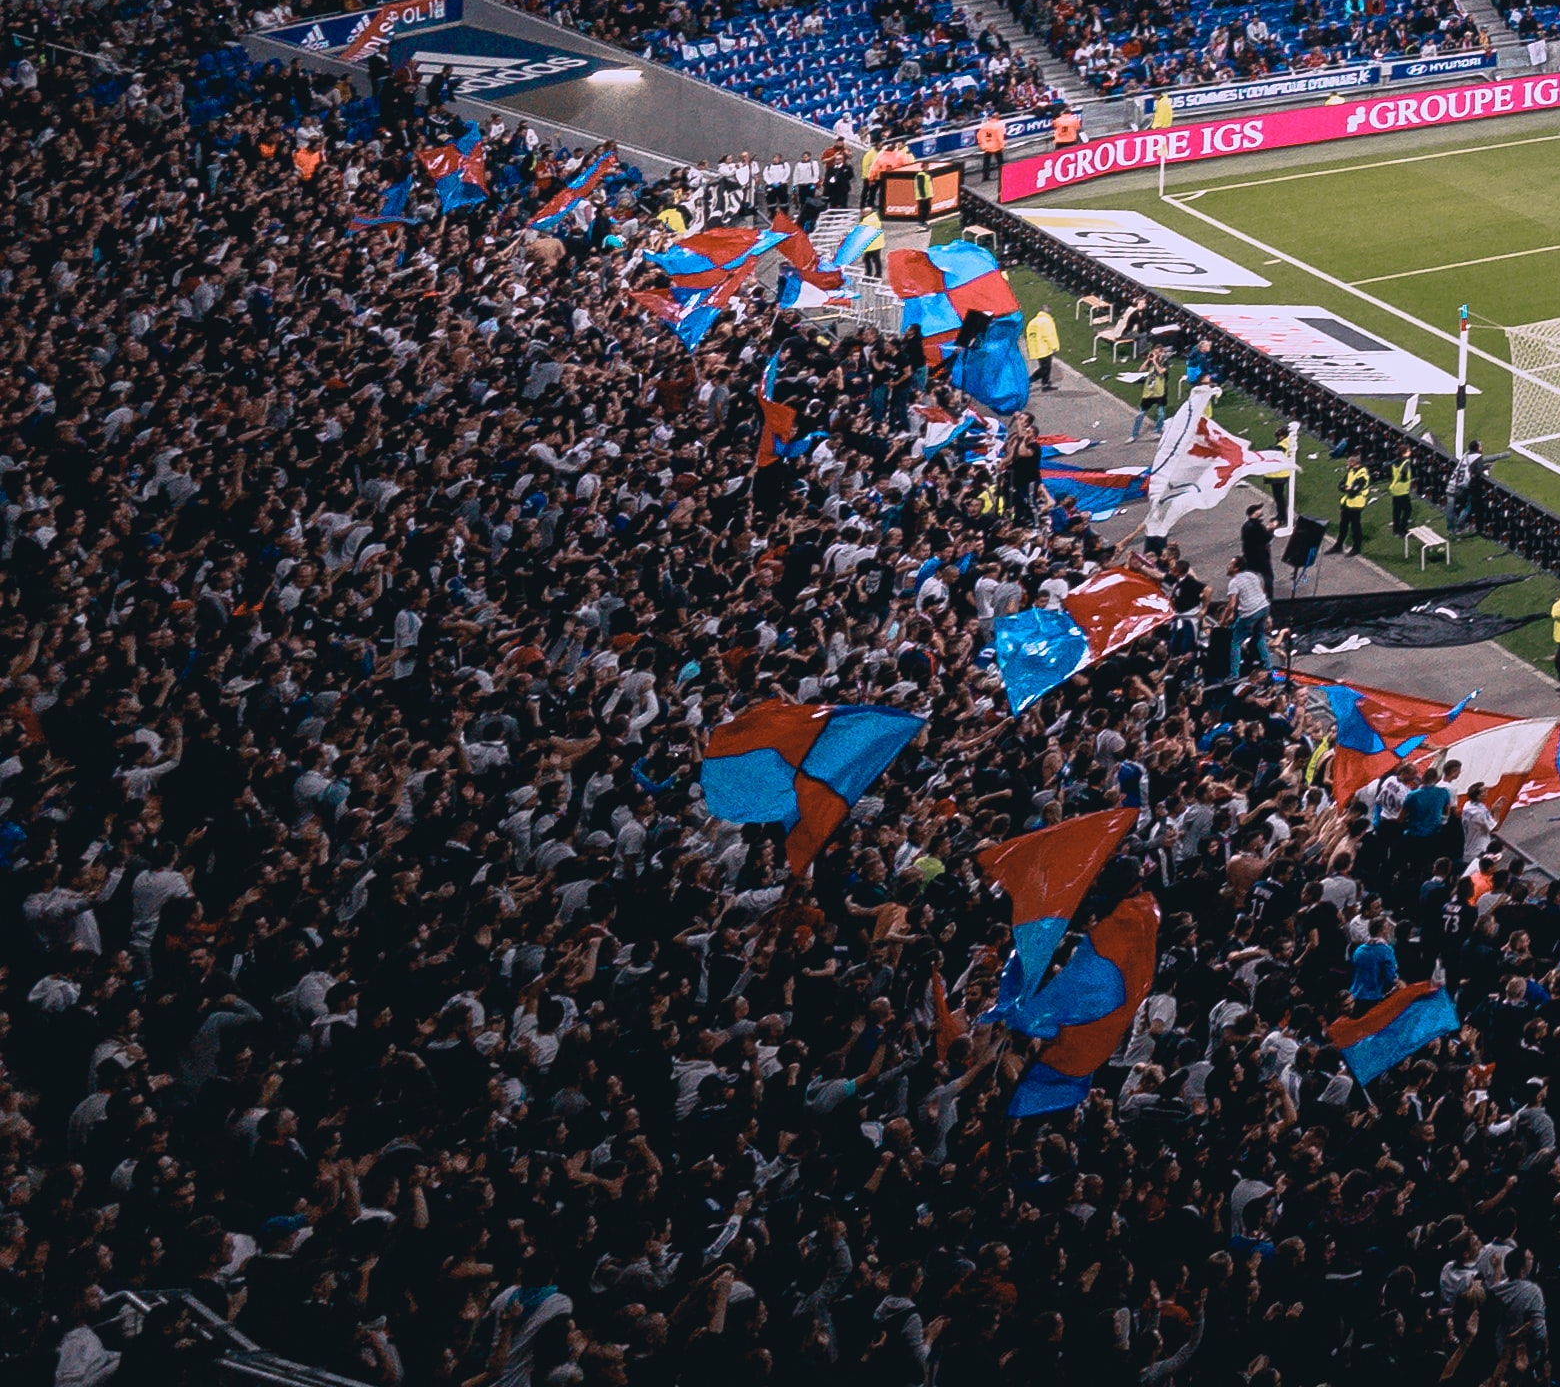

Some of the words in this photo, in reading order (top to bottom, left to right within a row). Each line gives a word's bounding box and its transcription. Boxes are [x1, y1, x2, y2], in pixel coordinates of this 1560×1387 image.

[1429, 57, 1480, 72] HYUNDAI
[1368, 85, 1513, 129] GROUPE
[1053, 131, 1192, 183] GROUPE
[1201, 120, 1264, 155] IGS
[1442, 914, 1460, 933] 73
